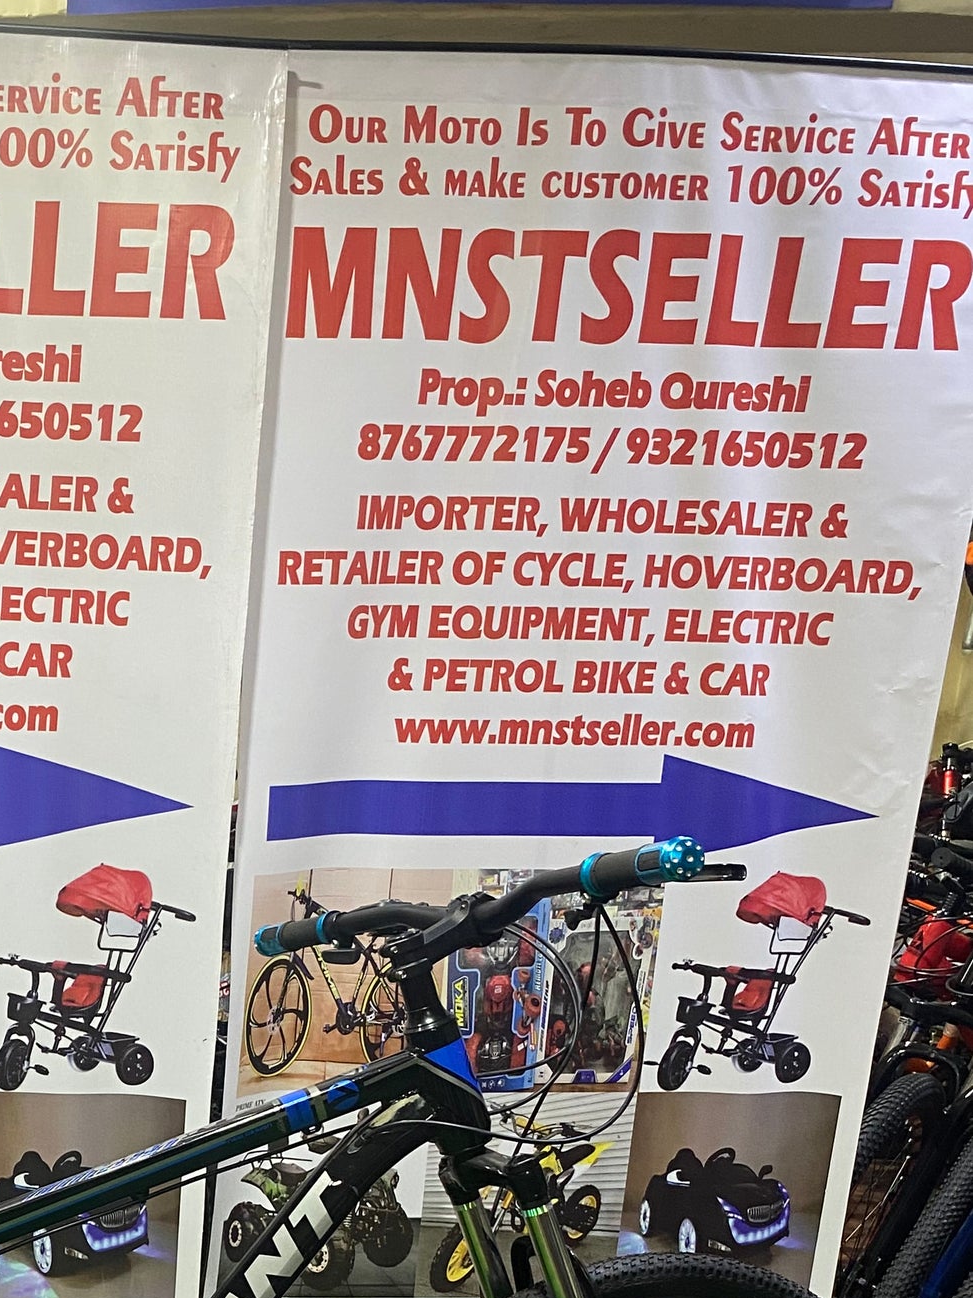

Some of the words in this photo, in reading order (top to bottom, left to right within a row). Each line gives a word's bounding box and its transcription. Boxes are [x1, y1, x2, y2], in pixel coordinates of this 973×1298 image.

[399, 157, 429, 196] &
[729, 166, 841, 205] 100%
[286, 226, 973, 350] MNSTSELLER
[418, 368, 527, 417] Prop.:
[535, 369, 652, 408] Soheb
[660, 372, 811, 412] Qureshi
[357, 423, 591, 463] 8767772175
[591, 428, 620, 474] /
[627, 428, 867, 469] 9321650512
[107, 477, 133, 514] &
[357, 495, 547, 537] IMPORTER,
[561, 498, 813, 537] WHOLESALER
[820, 503, 848, 538] &
[278, 550, 443, 585] RETAILER
[452, 551, 506, 586] OF
[513, 552, 633, 593] CYCLE,
[643, 554, 920, 600] HOVERBOARD,
[348, 605, 419, 639] GYM
[428, 605, 654, 647] EQUIPMENT,
[664, 609, 834, 646] ELECTRIC
[387, 658, 412, 691] &
[423, 658, 563, 693] PETROL
[573, 660, 657, 694] BIKE
[664, 662, 689, 695] &
[700, 663, 770, 696] CAR
[395, 714, 755, 748] www.mnstseller.com
[455, 980, 465, 1026] MOKA
